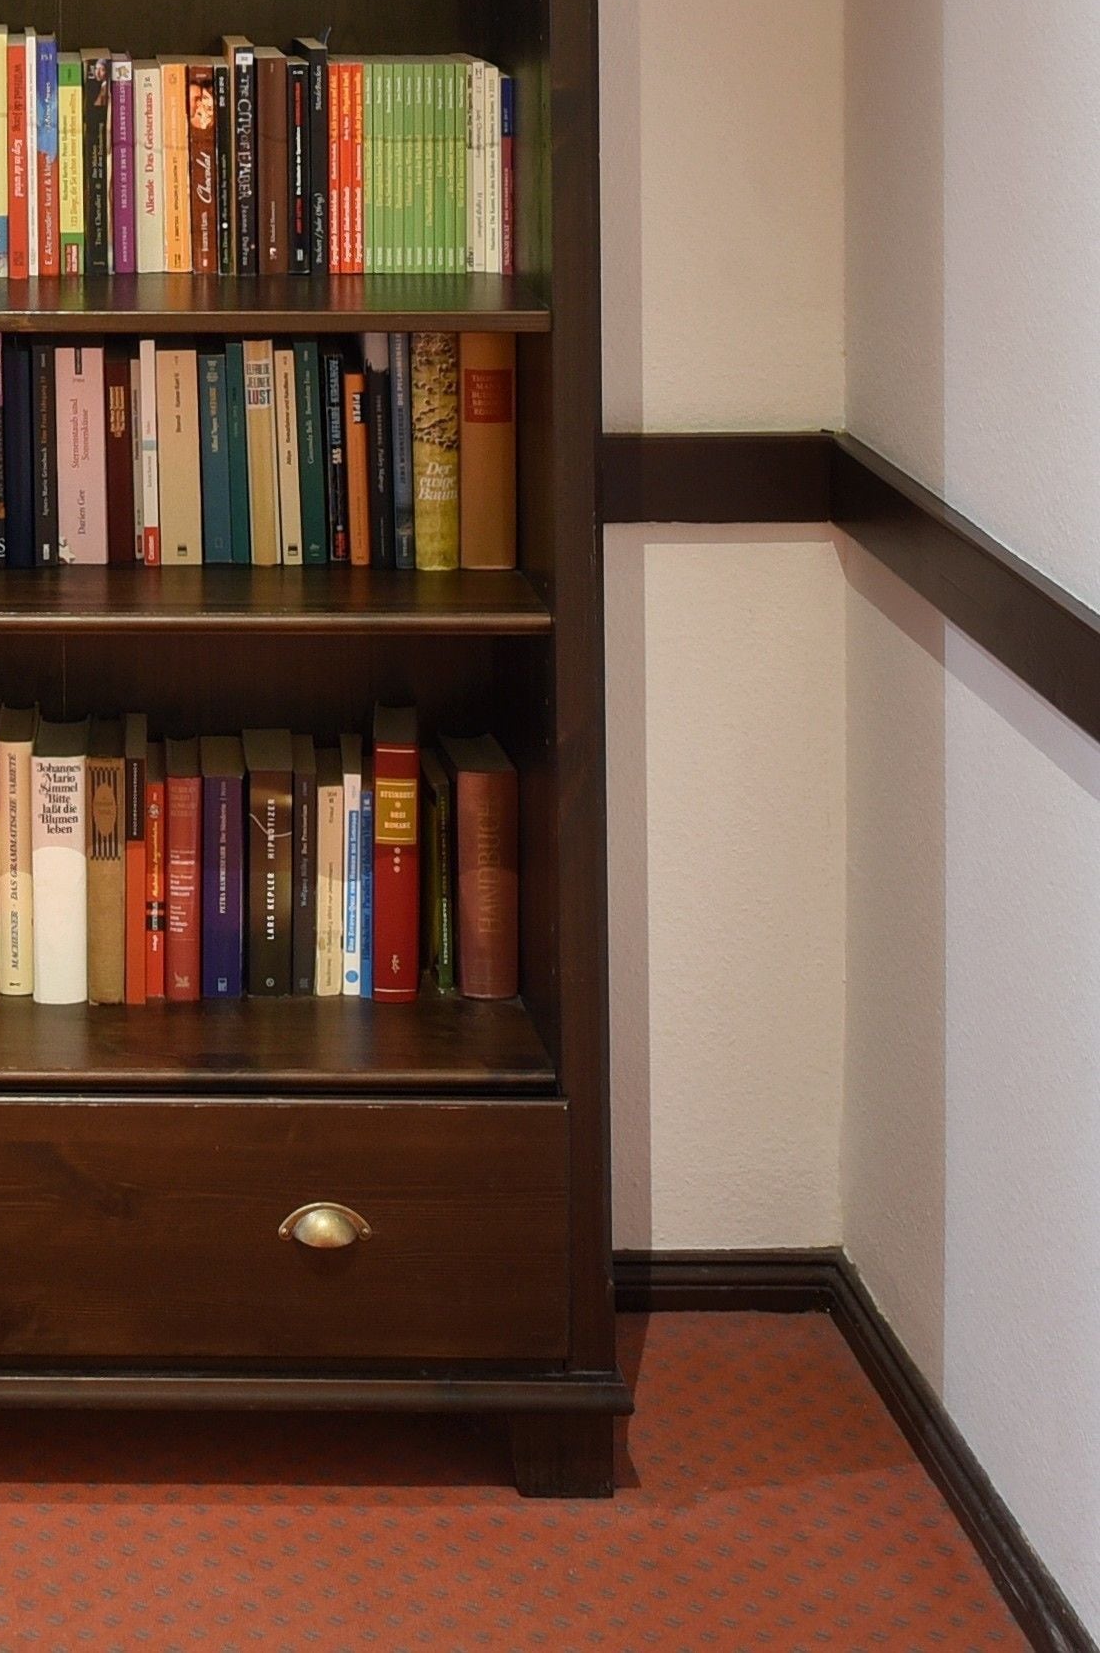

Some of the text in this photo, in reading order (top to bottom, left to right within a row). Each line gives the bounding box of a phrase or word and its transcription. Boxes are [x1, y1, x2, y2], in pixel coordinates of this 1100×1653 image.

[14, 63, 22, 111] Wilfried de
[120, 107, 128, 183] GARNETT DAME ZU
[144, 93, 154, 215] Allende Das Geisterhaus
[238, 99, 252, 199] CITY EMBER
[12, 139, 24, 197] Kop in de wind
[44, 187, 54, 207] kurz
[94, 193, 102, 245] Tracy Chevalier
[247, 389, 270, 405] LUST
[328, 359, 342, 463] SAS L'AFFAIRE KIRSANOV
[352, 393, 360, 423] PIPER
[70, 399, 80, 469] Sternenstaub und
[426, 462, 451, 477] Der
[76, 489, 86, 535] Darien Gee
[419, 489, 458, 501] Baum
[36, 761, 81, 773] Johannes
[39, 782, 78, 794] Simmel
[44, 773, 76, 783] Mario
[38, 813, 79, 824] Blumen
[42, 803, 77, 814] laßt die
[48, 793, 71, 804] Bitte
[46, 824, 73, 835] leben
[8, 797, 20, 971] MACHEINER DAS GRAMMATISCHE
[266, 799, 276, 939] LARS KEPLER HIPNOTIZER
[362, 865, 370, 909] Paradies der
[476, 803, 500, 933] HANDBUCH
